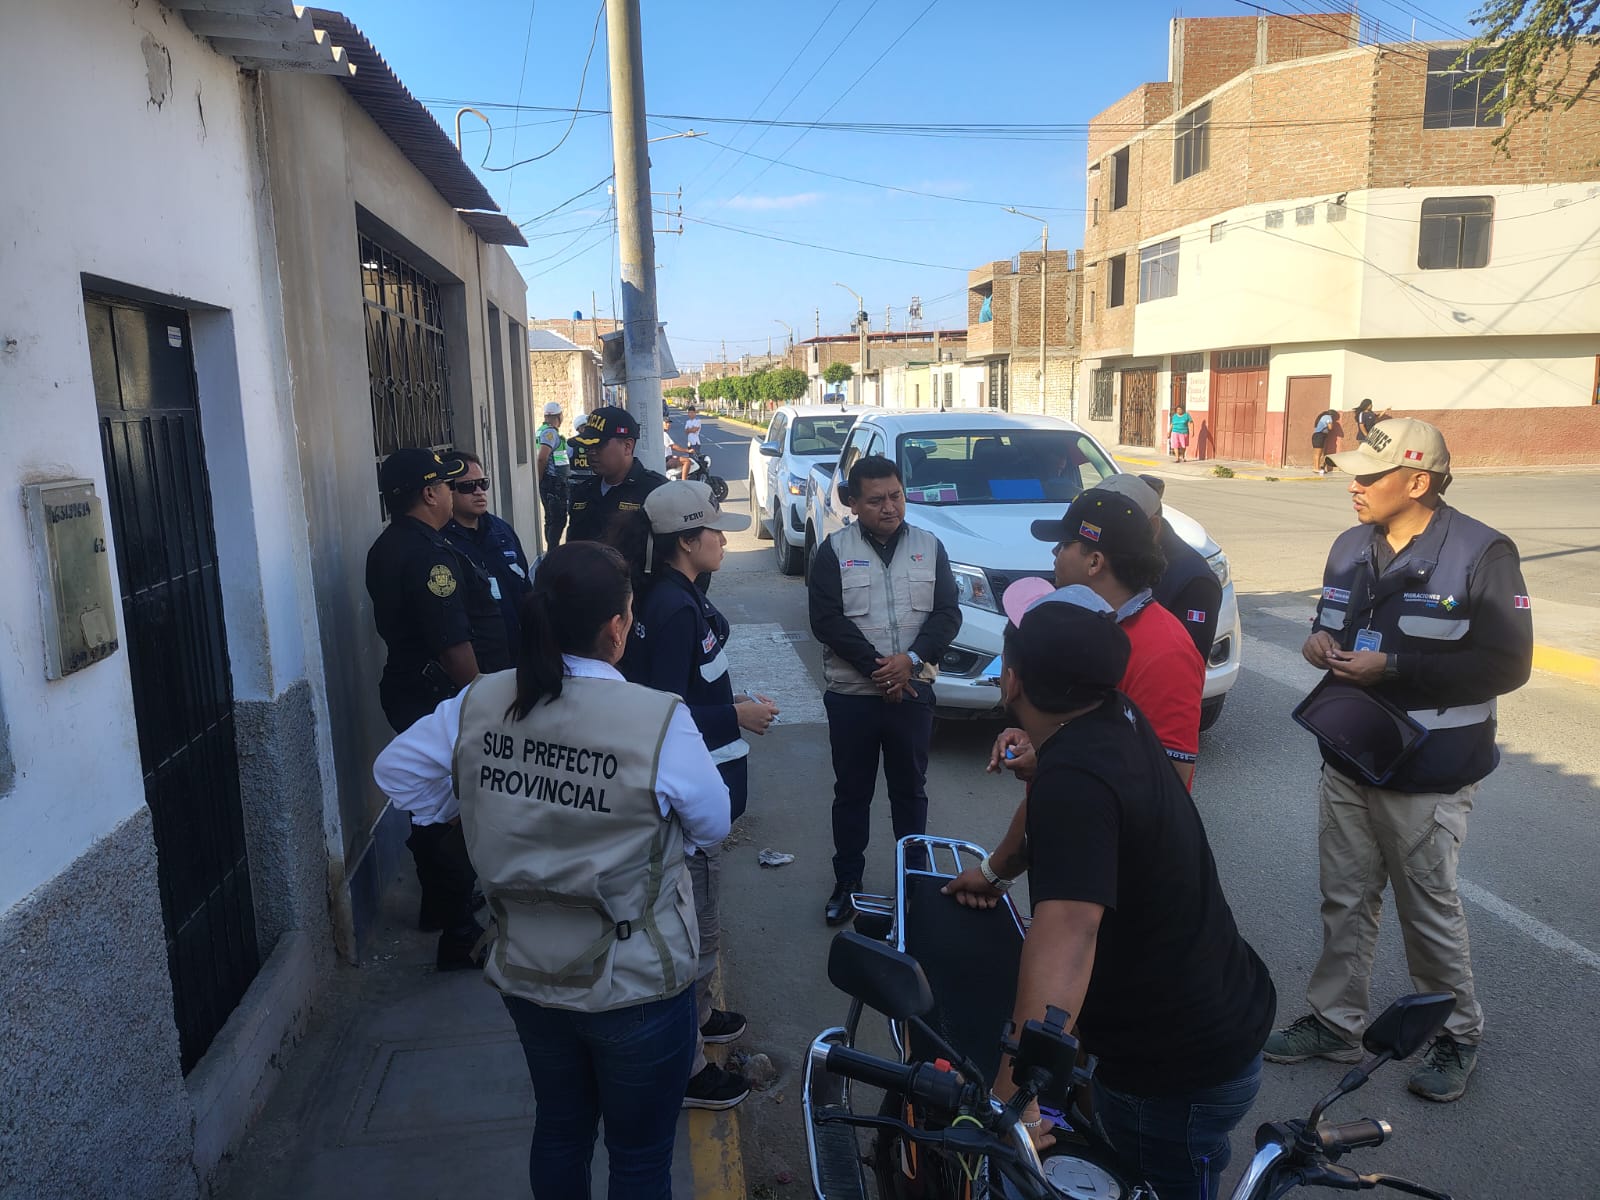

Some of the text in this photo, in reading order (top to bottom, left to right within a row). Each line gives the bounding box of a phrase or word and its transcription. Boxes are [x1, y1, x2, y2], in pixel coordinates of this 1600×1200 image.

[574, 458, 590, 468] POL
[683, 511, 704, 522] PERU
[483, 731, 618, 779] SUB PREFECTO
[480, 765, 612, 813] PROVINCIAL
